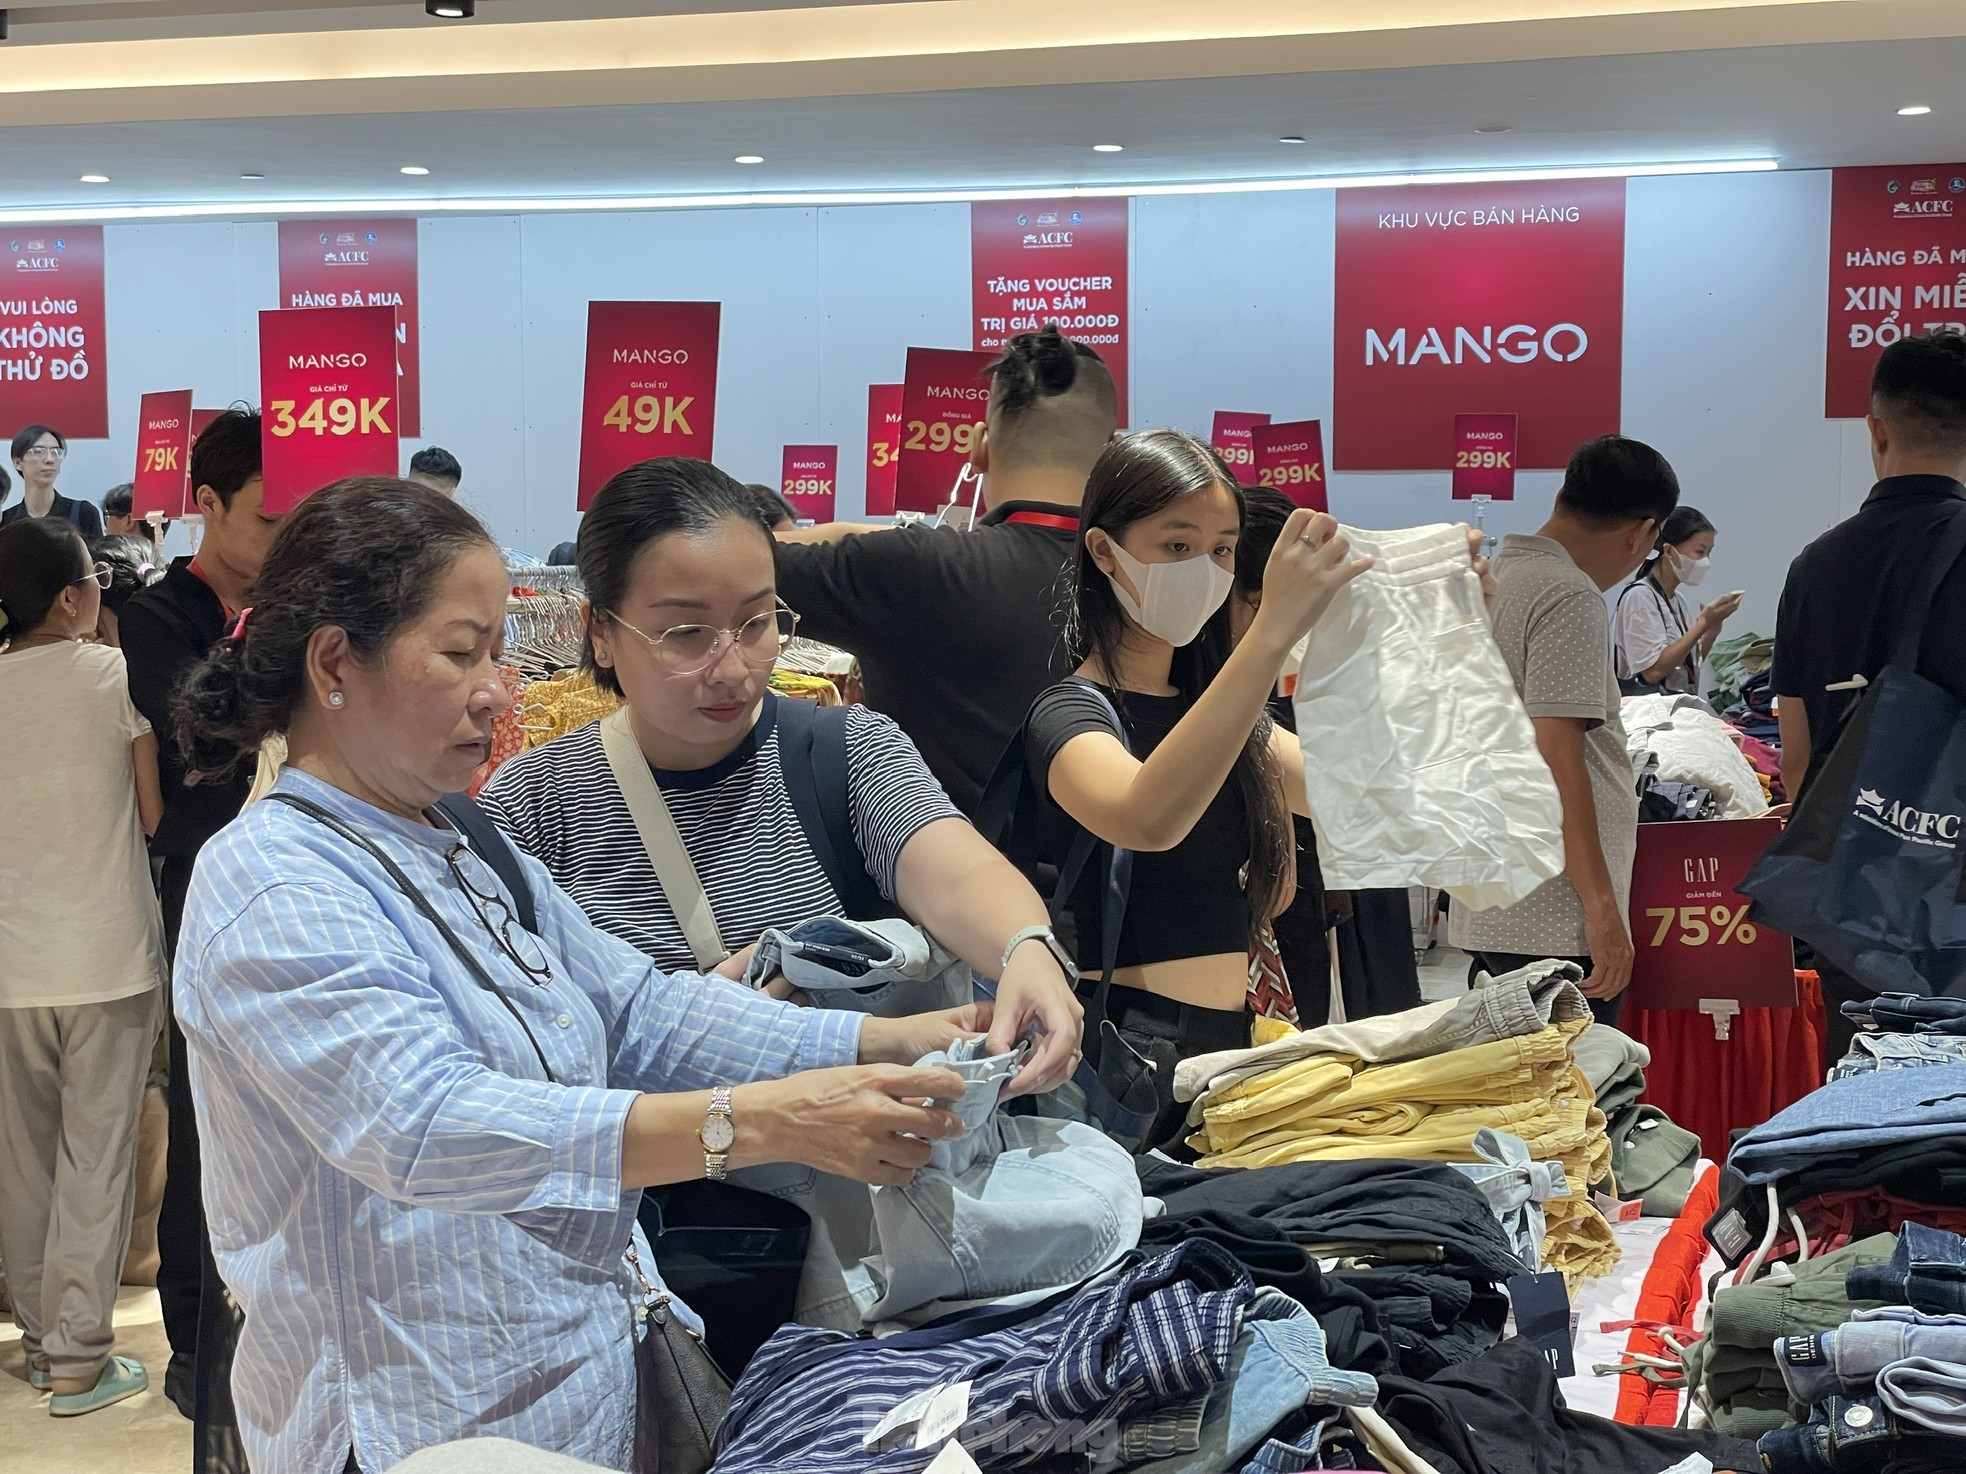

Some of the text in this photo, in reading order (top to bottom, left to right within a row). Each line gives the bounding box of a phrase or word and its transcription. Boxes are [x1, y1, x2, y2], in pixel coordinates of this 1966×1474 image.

[1911, 200, 1953, 213] ACFC
[1378, 204, 1580, 230] KHU VỰC BÁN HÀNG
[1038, 231, 1073, 244] ACFC
[29, 257, 59, 269] ACFC
[338, 251, 369, 262] ACFC
[1846, 247, 1907, 267] HÀNG
[1912, 246, 1943, 265] ĐÃ
[987, 276, 1113, 296] TẶNG VOUCHER
[1844, 272, 1966, 311] XIN MIỄ
[0, 296, 78, 316] VUI LÒNG
[292, 290, 404, 307] HÀNG ĐÃ MUA
[1013, 291, 1087, 312] MUA SẮM
[980, 317, 1006, 333] TRỊ
[1009, 313, 1039, 330] GIÁ
[981, 337, 999, 347] cho
[1364, 322, 1589, 367] MANGO
[50, 349, 89, 380] ĐỒ
[288, 352, 368, 370] MANGO
[612, 348, 689, 365] MANGO
[309, 384, 323, 393] GIÁ
[324, 383, 337, 392] CHỈ
[926, 385, 991, 401] MANGO
[148, 418, 180, 431] MANGO
[270, 396, 393, 438] 349K
[603, 395, 695, 436] 49K
[904, 420, 974, 454] 299
[1223, 429, 1252, 438] MANG
[1466, 432, 1504, 440] MANGO
[1267, 442, 1309, 454] MANGO
[143, 446, 180, 473] 79K
[793, 461, 826, 470] MANGO
[1456, 451, 1512, 469] 299K
[1259, 462, 1322, 487] 299K
[783, 479, 833, 495] 299K
[1882, 800, 1961, 839] ACFC
[1684, 857, 1719, 883] GAP
[1645, 904, 1758, 947] 75%
[1718, 1222, 1742, 1249] GAP
[1789, 1336, 1810, 1361] GAP
